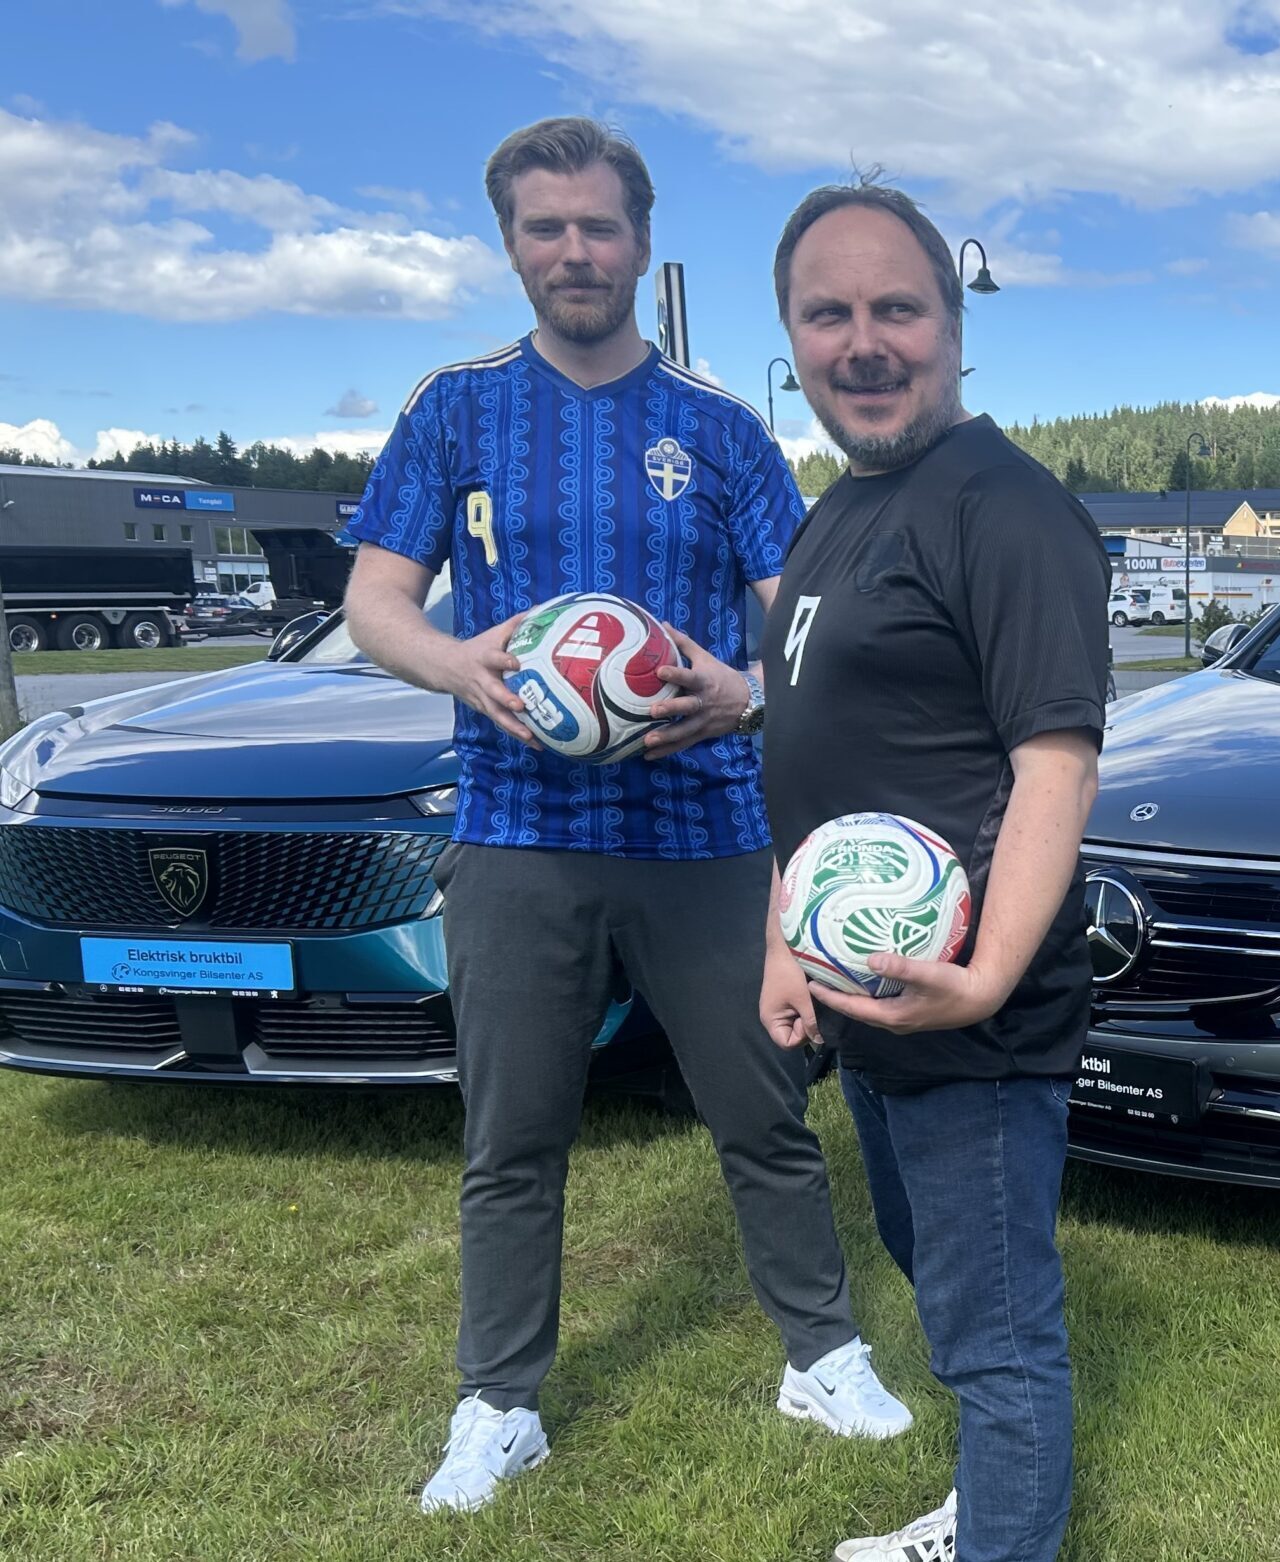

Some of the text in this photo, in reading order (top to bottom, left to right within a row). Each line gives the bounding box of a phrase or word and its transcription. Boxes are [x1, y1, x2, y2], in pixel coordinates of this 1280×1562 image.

[467, 491, 498, 567] 9
[1124, 559, 1157, 570] 100M
[784, 595, 822, 686] 9
[830, 844, 893, 854] TRIONDA
[127, 949, 243, 964] Elektrisk bruktbil
[133, 968, 263, 980] Kongsvinger Bilsenter AS
[1081, 1055, 1111, 1074] ktbil
[1097, 1079, 1144, 1096] Bilsenter
[1146, 1088, 1163, 1099] AS
